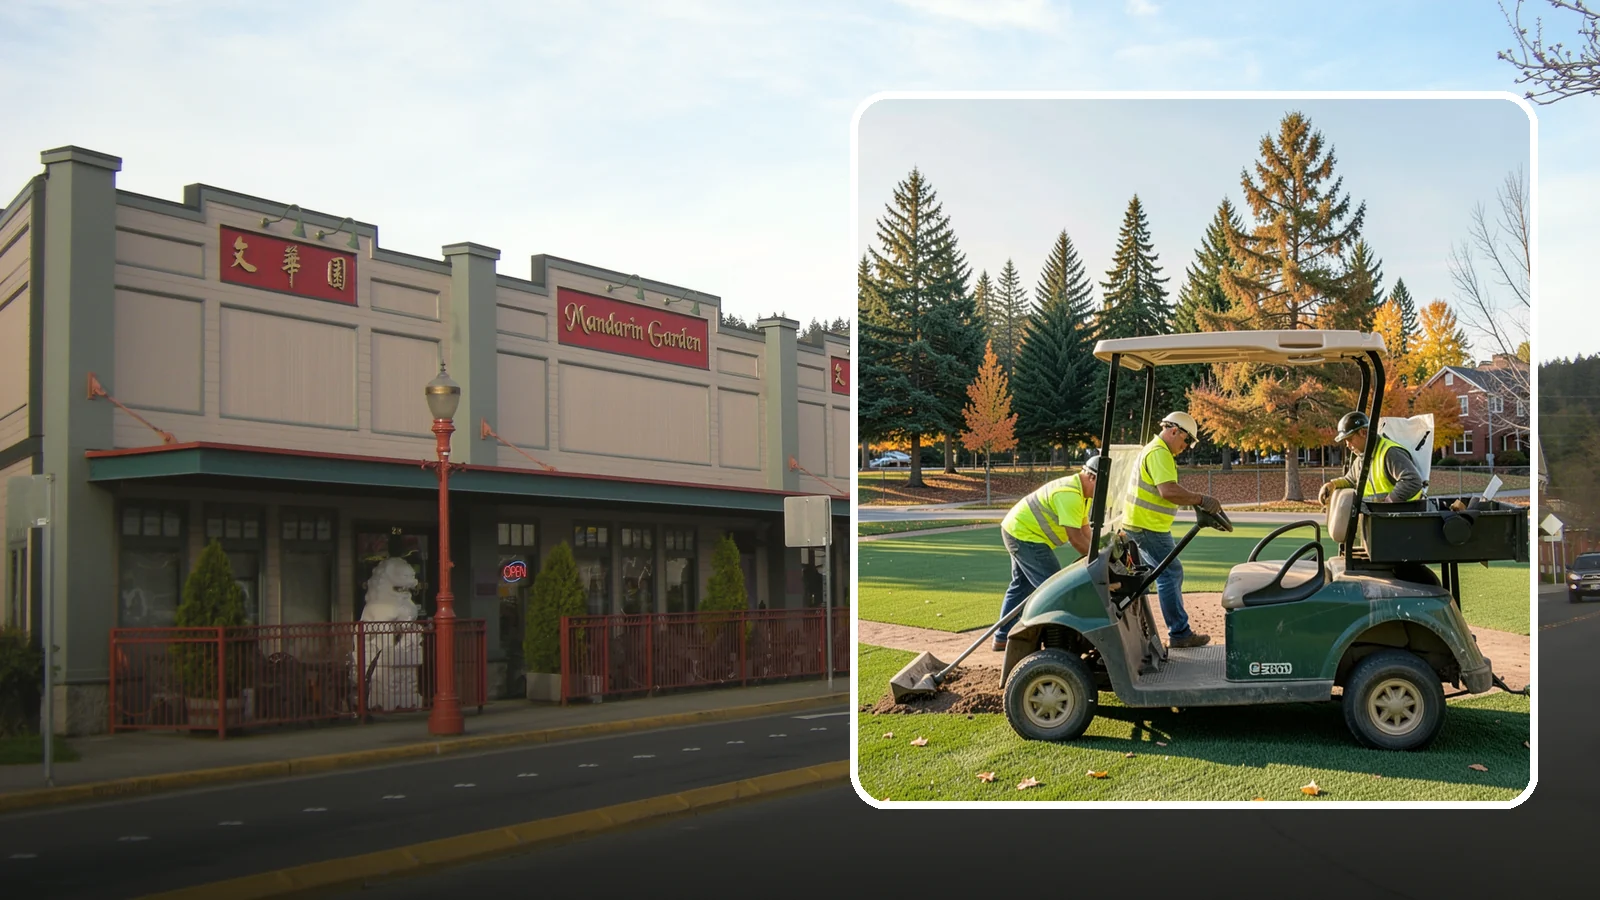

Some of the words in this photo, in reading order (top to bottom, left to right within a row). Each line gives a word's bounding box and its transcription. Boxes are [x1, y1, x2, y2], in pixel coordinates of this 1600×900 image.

[231, 235, 346, 291] 文華園
[564, 302, 644, 341] Mandarin
[648, 320, 701, 352] Garden
[503, 565, 527, 578] OPEN
